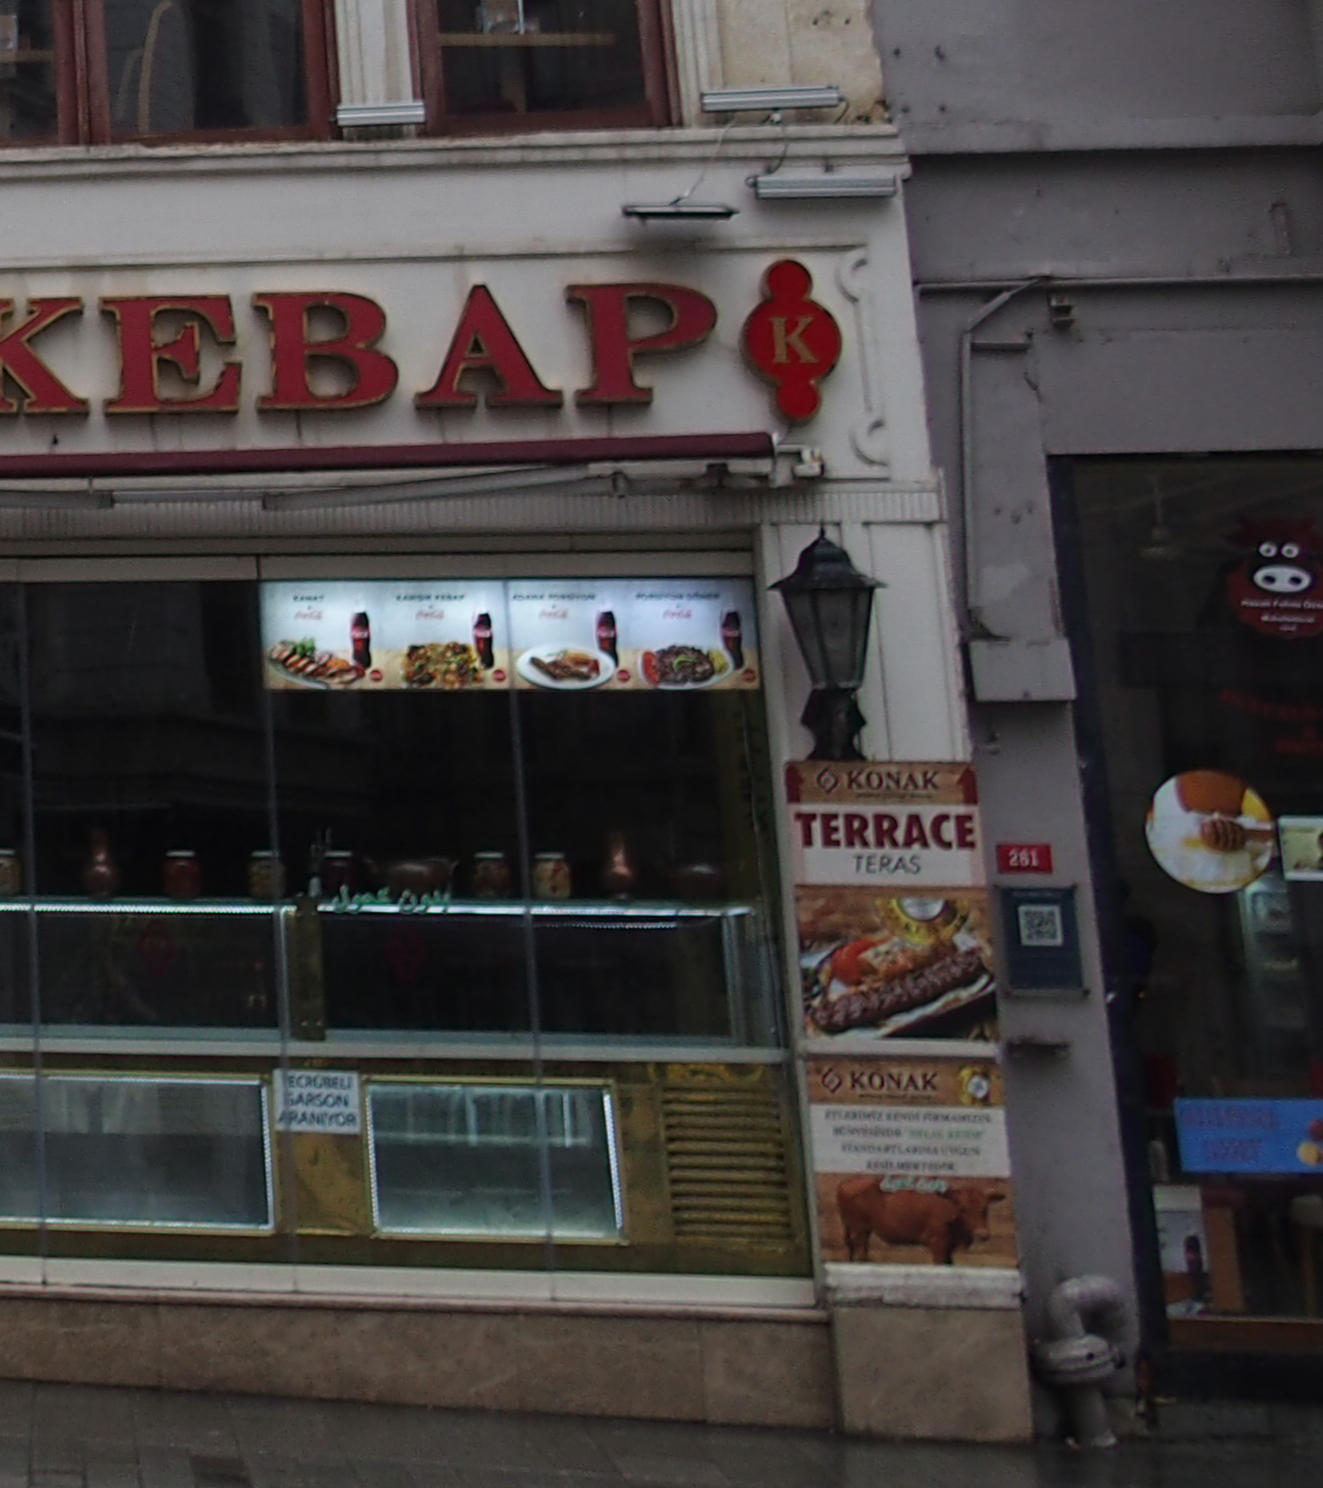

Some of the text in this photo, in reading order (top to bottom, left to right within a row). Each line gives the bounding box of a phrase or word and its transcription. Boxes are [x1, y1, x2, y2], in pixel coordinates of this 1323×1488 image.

[772, 317, 817, 364] K
[848, 769, 939, 790] KONAK
[796, 811, 976, 850] TERRACE
[854, 853, 922, 876] TERAS
[1007, 848, 1040, 868] 261
[285, 1073, 353, 1090] ECRÜBELİ
[849, 1070, 938, 1091] KONAK
